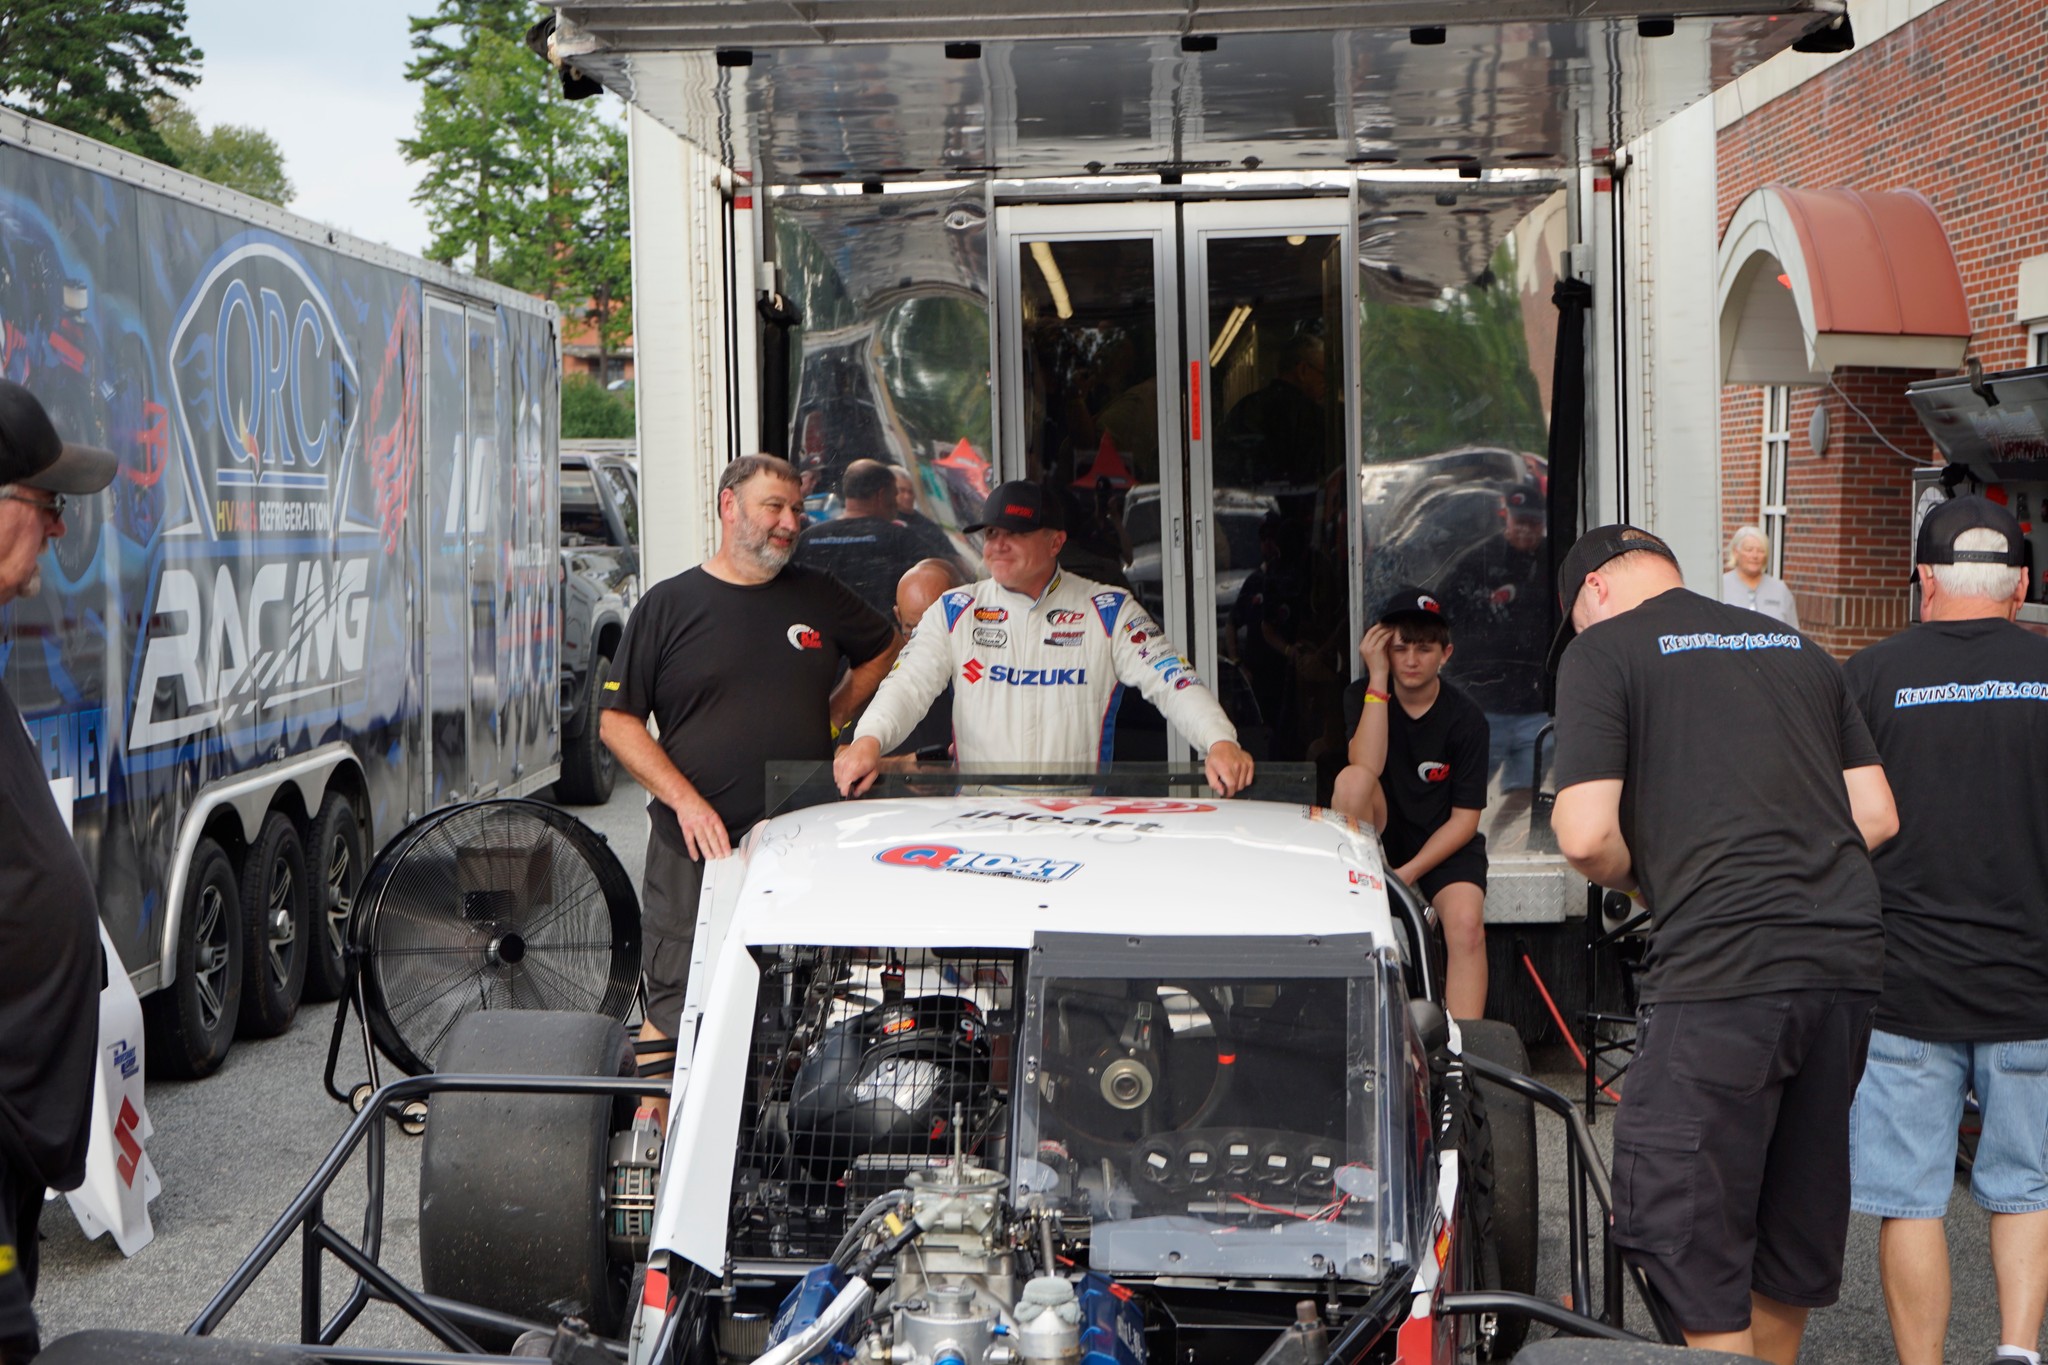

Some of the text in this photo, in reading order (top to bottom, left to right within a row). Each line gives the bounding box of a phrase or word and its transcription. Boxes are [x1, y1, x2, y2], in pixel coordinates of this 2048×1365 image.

[215, 279, 328, 475] QRC
[216, 499, 249, 532] HVAC
[259, 500, 331, 532] REFRIGERATION
[128, 558, 370, 750] RACING
[989, 665, 1086, 685] SUZUKI
